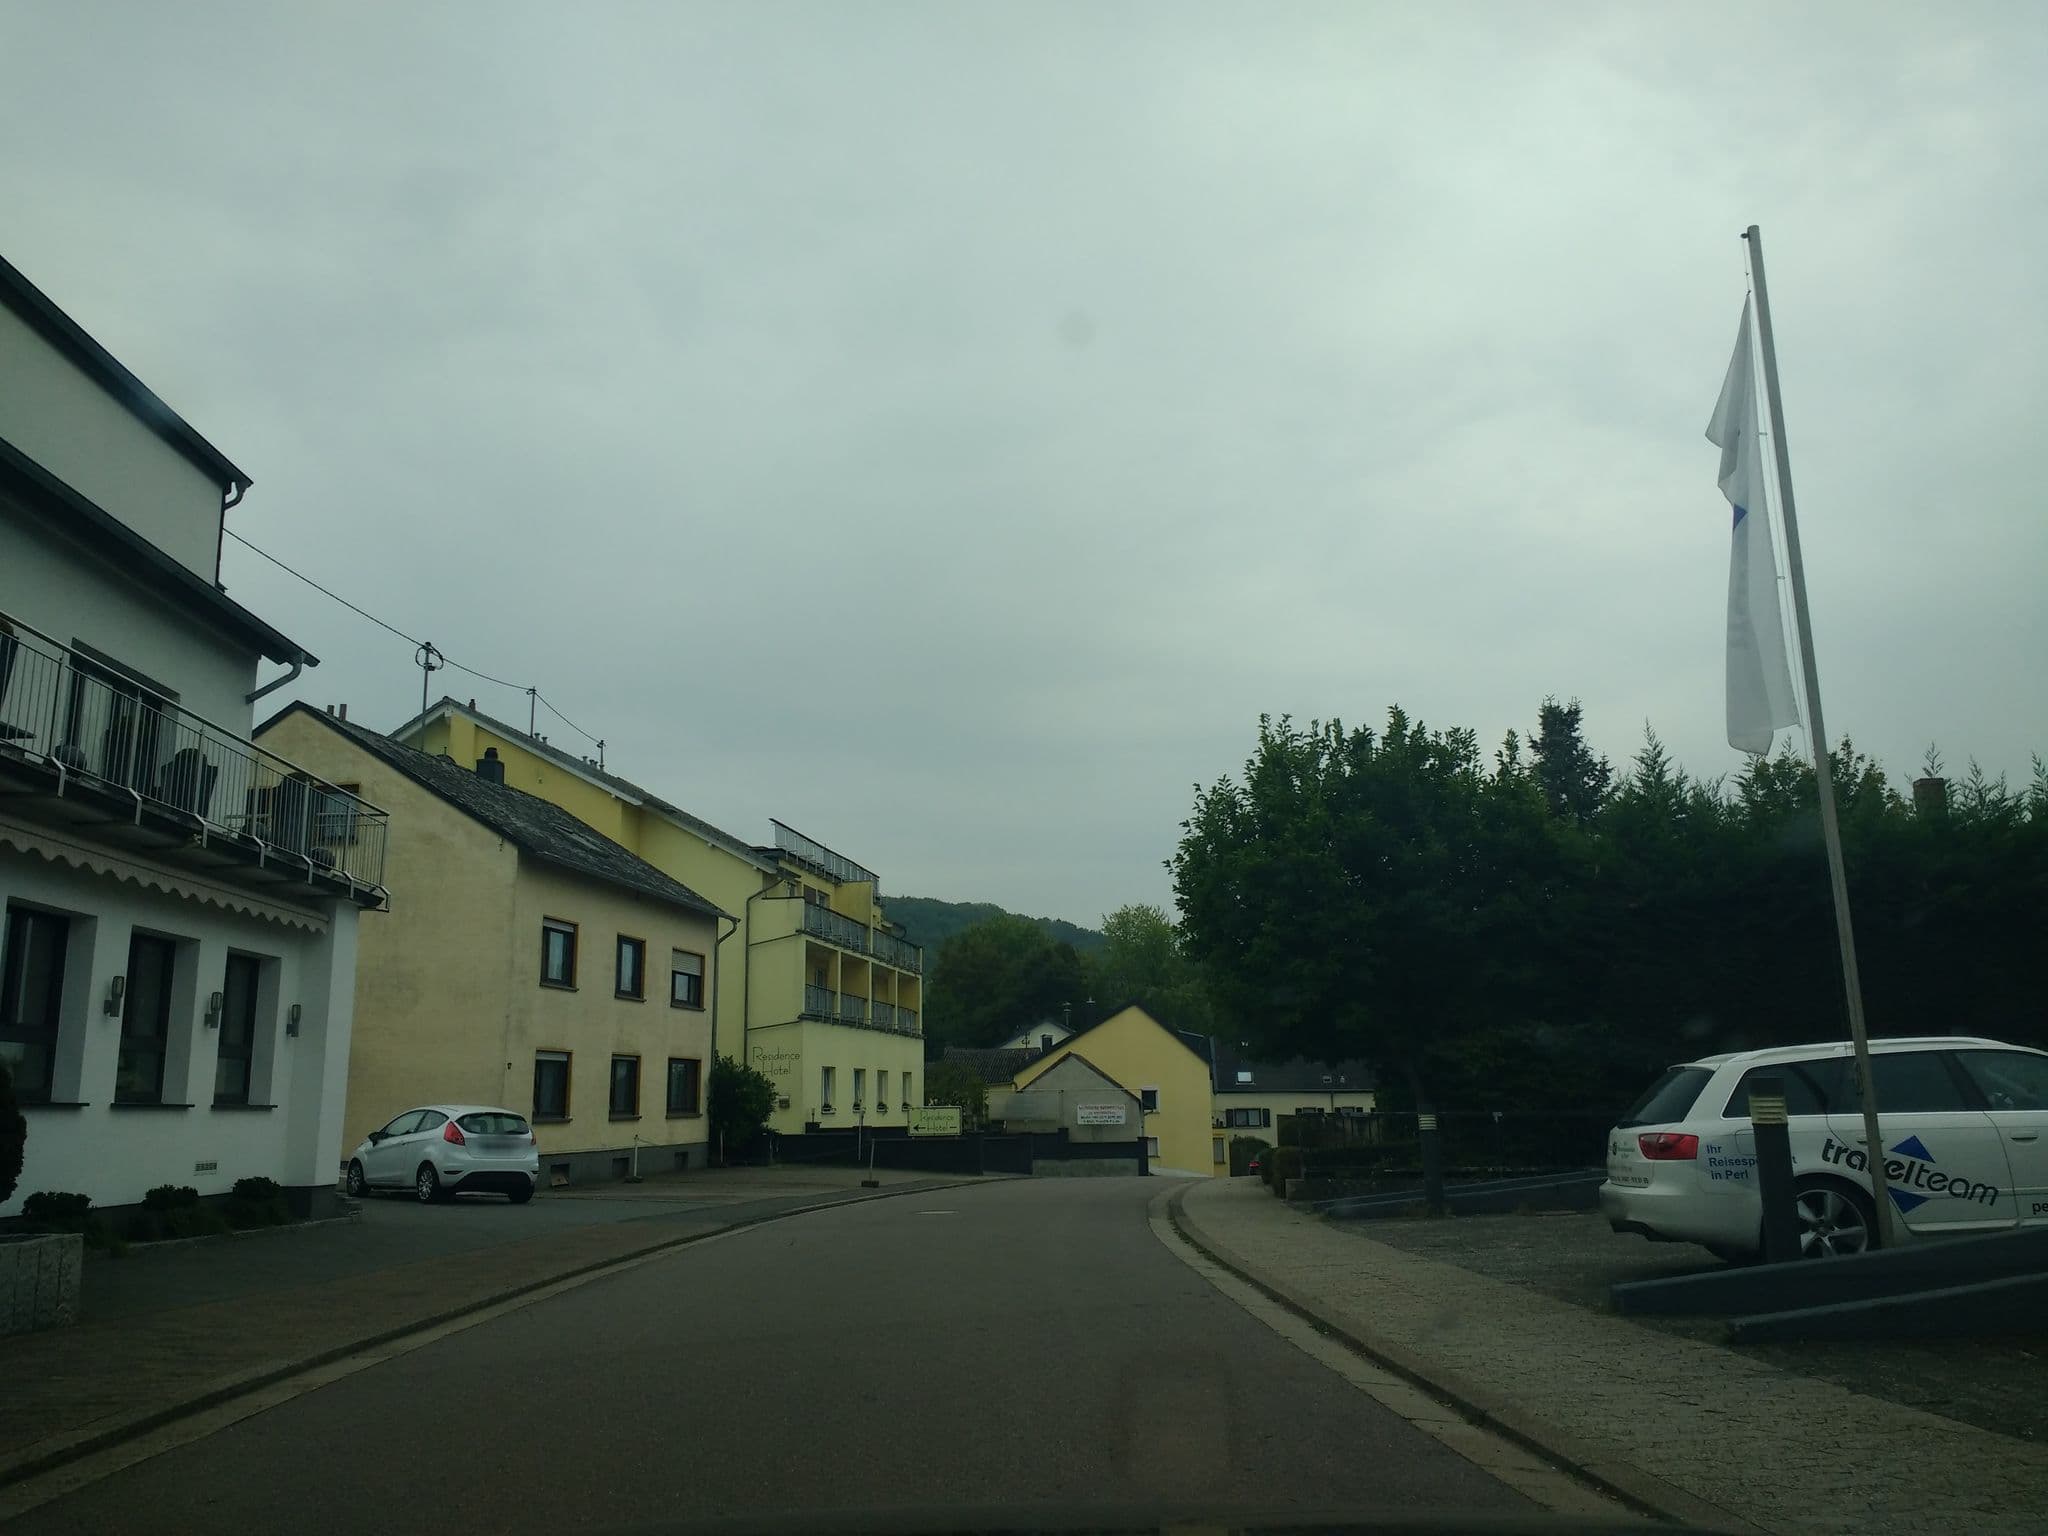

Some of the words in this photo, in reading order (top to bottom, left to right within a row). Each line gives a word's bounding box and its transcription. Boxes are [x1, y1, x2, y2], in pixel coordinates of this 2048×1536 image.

[752, 1046, 800, 1063] Residence
[762, 1060, 791, 1077] Hotel
[1706, 1145, 1722, 1154] Ihr
[1711, 1169, 1722, 1180] in
[1725, 1169, 1749, 1180] Perl
